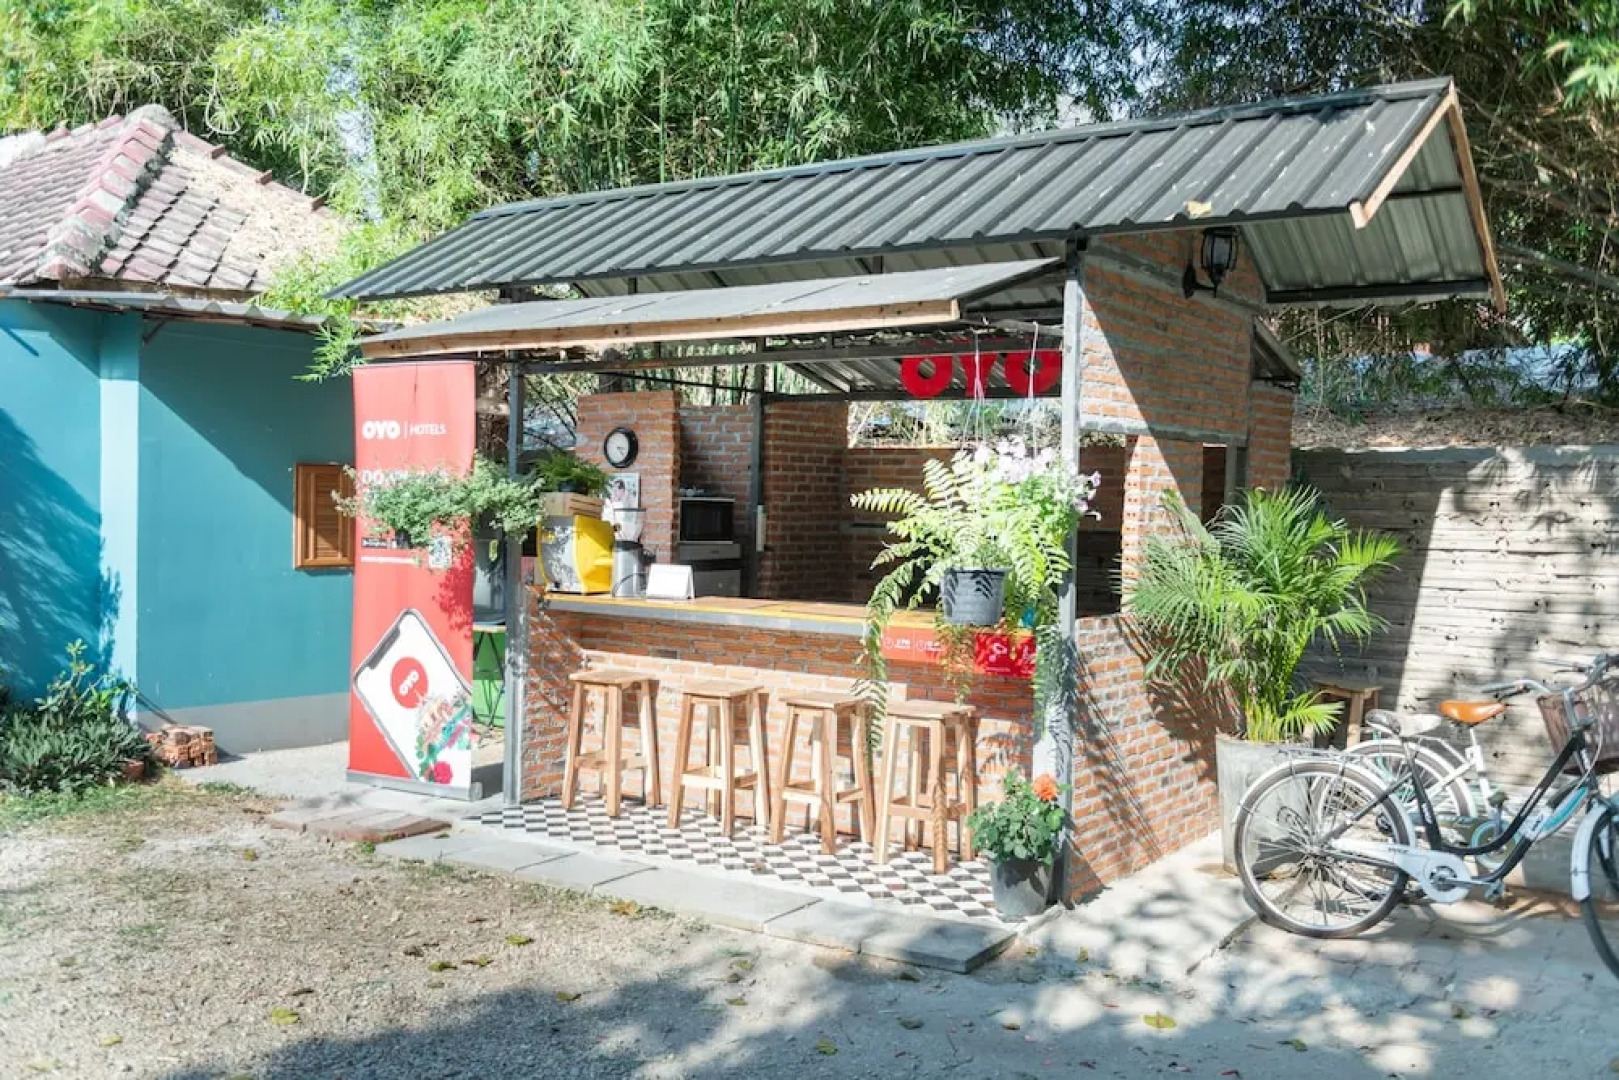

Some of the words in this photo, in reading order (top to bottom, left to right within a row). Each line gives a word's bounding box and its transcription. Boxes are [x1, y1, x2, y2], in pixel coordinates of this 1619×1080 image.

[899, 348, 1062, 398] OYO
[362, 419, 401, 440] OYO
[408, 423, 446, 436] HOTELS
[399, 667, 419, 687] OYO
